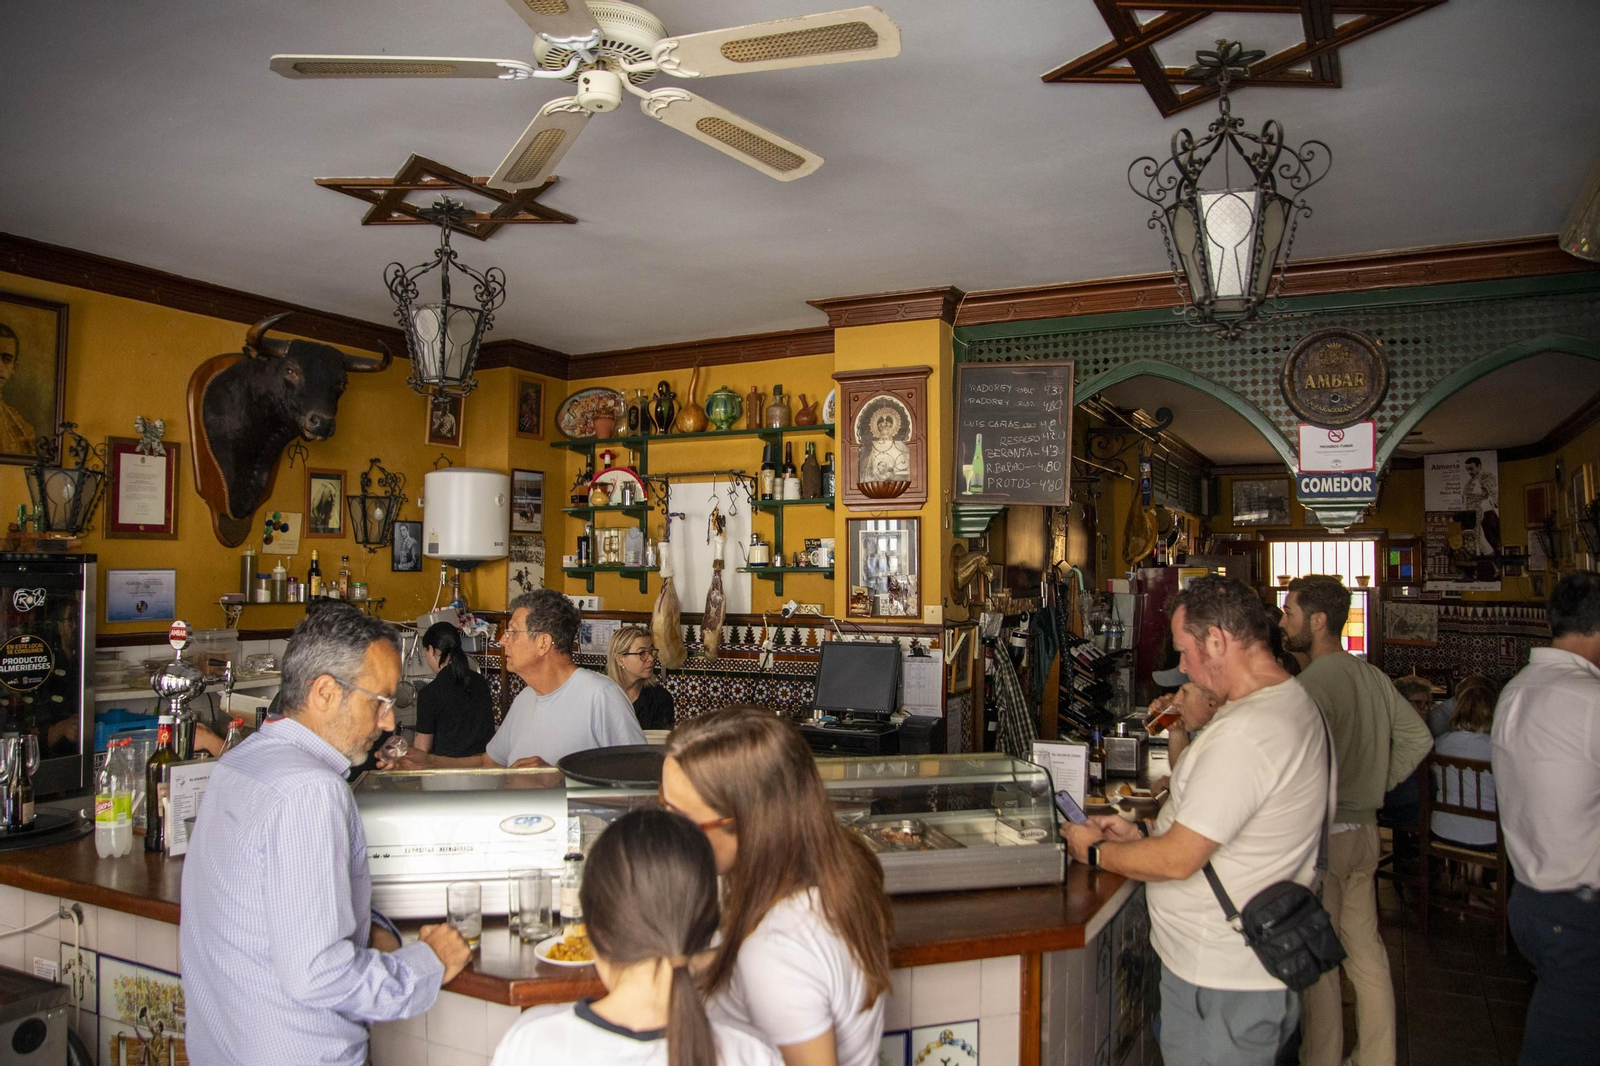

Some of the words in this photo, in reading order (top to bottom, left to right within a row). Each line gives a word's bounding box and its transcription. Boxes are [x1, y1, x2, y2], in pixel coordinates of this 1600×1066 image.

[1304, 372, 1365, 389] AMBAR
[987, 477, 1031, 489] PROTOS
[1301, 476, 1372, 493] COMEDOR
[2, 655, 48, 665] PRODUCTOS
